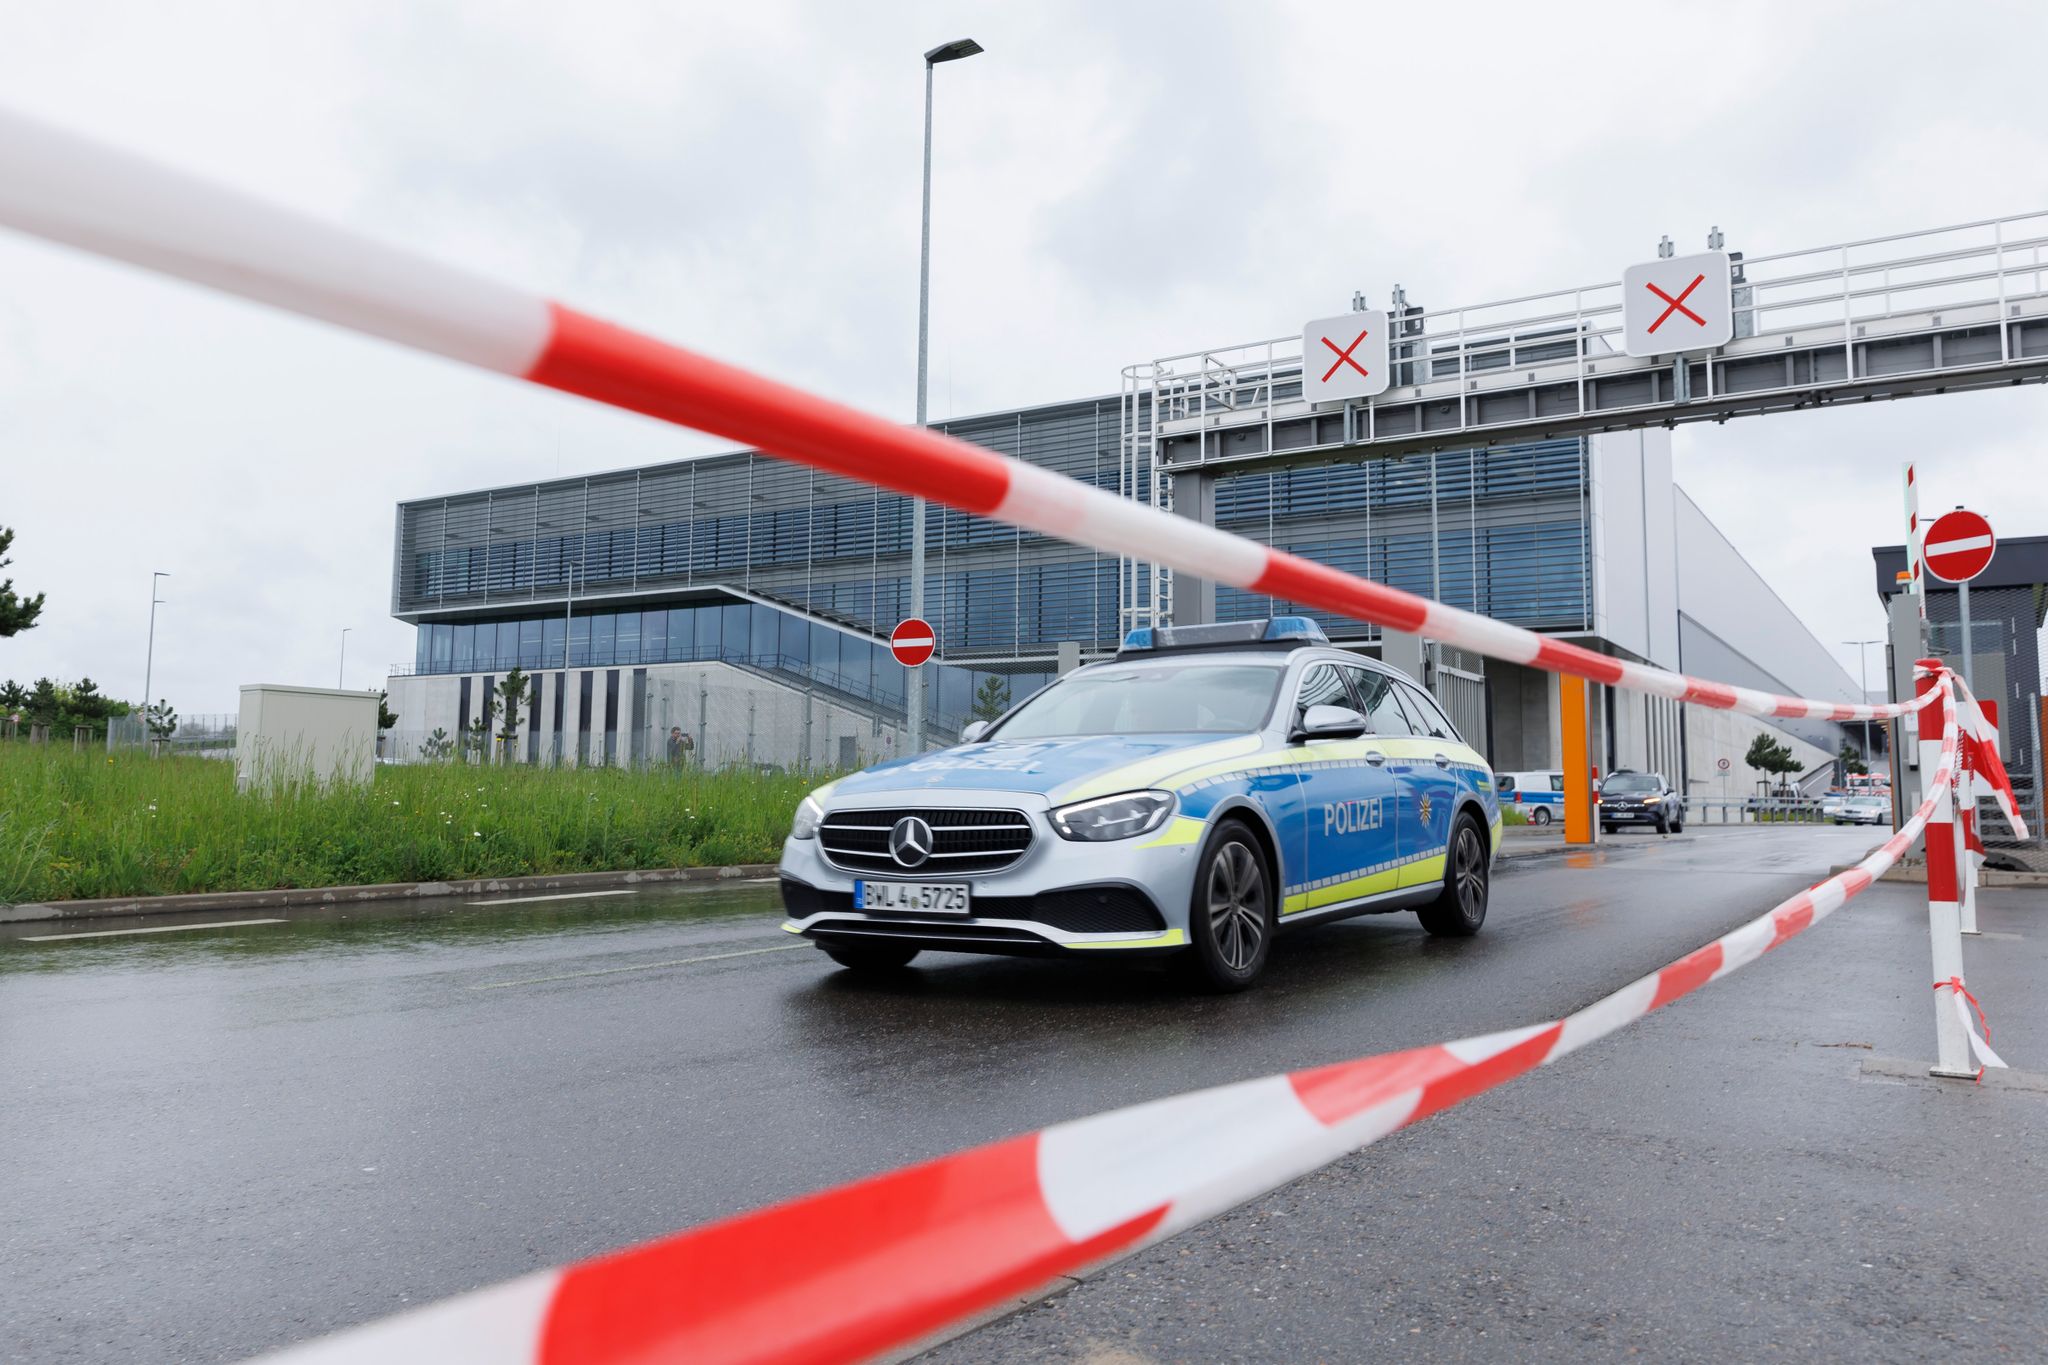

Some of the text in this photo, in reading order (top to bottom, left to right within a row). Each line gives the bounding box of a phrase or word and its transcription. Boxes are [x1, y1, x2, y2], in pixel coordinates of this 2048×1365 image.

[1323, 797, 1383, 837] POLIZEI
[865, 884, 965, 909] BWL 4 5725
